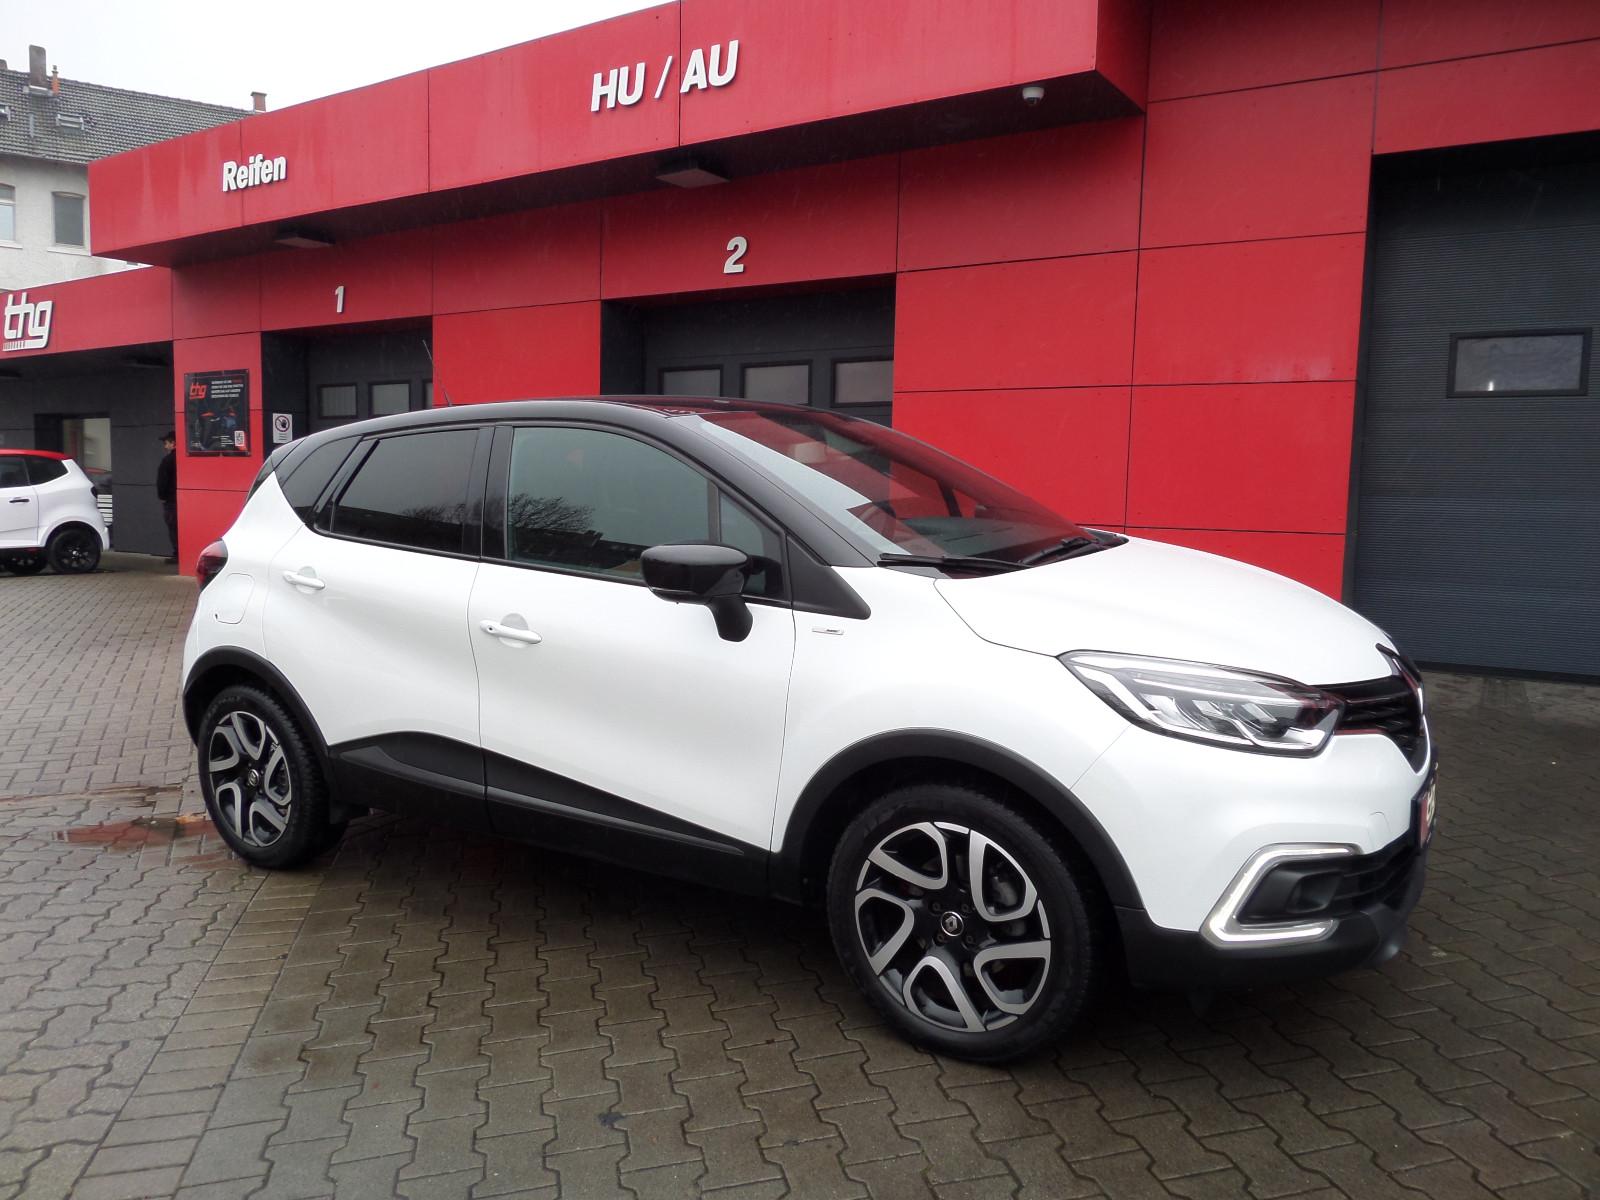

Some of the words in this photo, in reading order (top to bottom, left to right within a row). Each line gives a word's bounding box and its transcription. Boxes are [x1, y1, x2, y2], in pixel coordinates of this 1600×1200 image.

[591, 62, 646, 112] HU
[654, 55, 673, 99] /
[680, 39, 739, 94] AU
[222, 153, 287, 192] Reifen
[723, 236, 747, 274] 2
[335, 285, 345, 313] 1
[3, 292, 53, 351] thg
